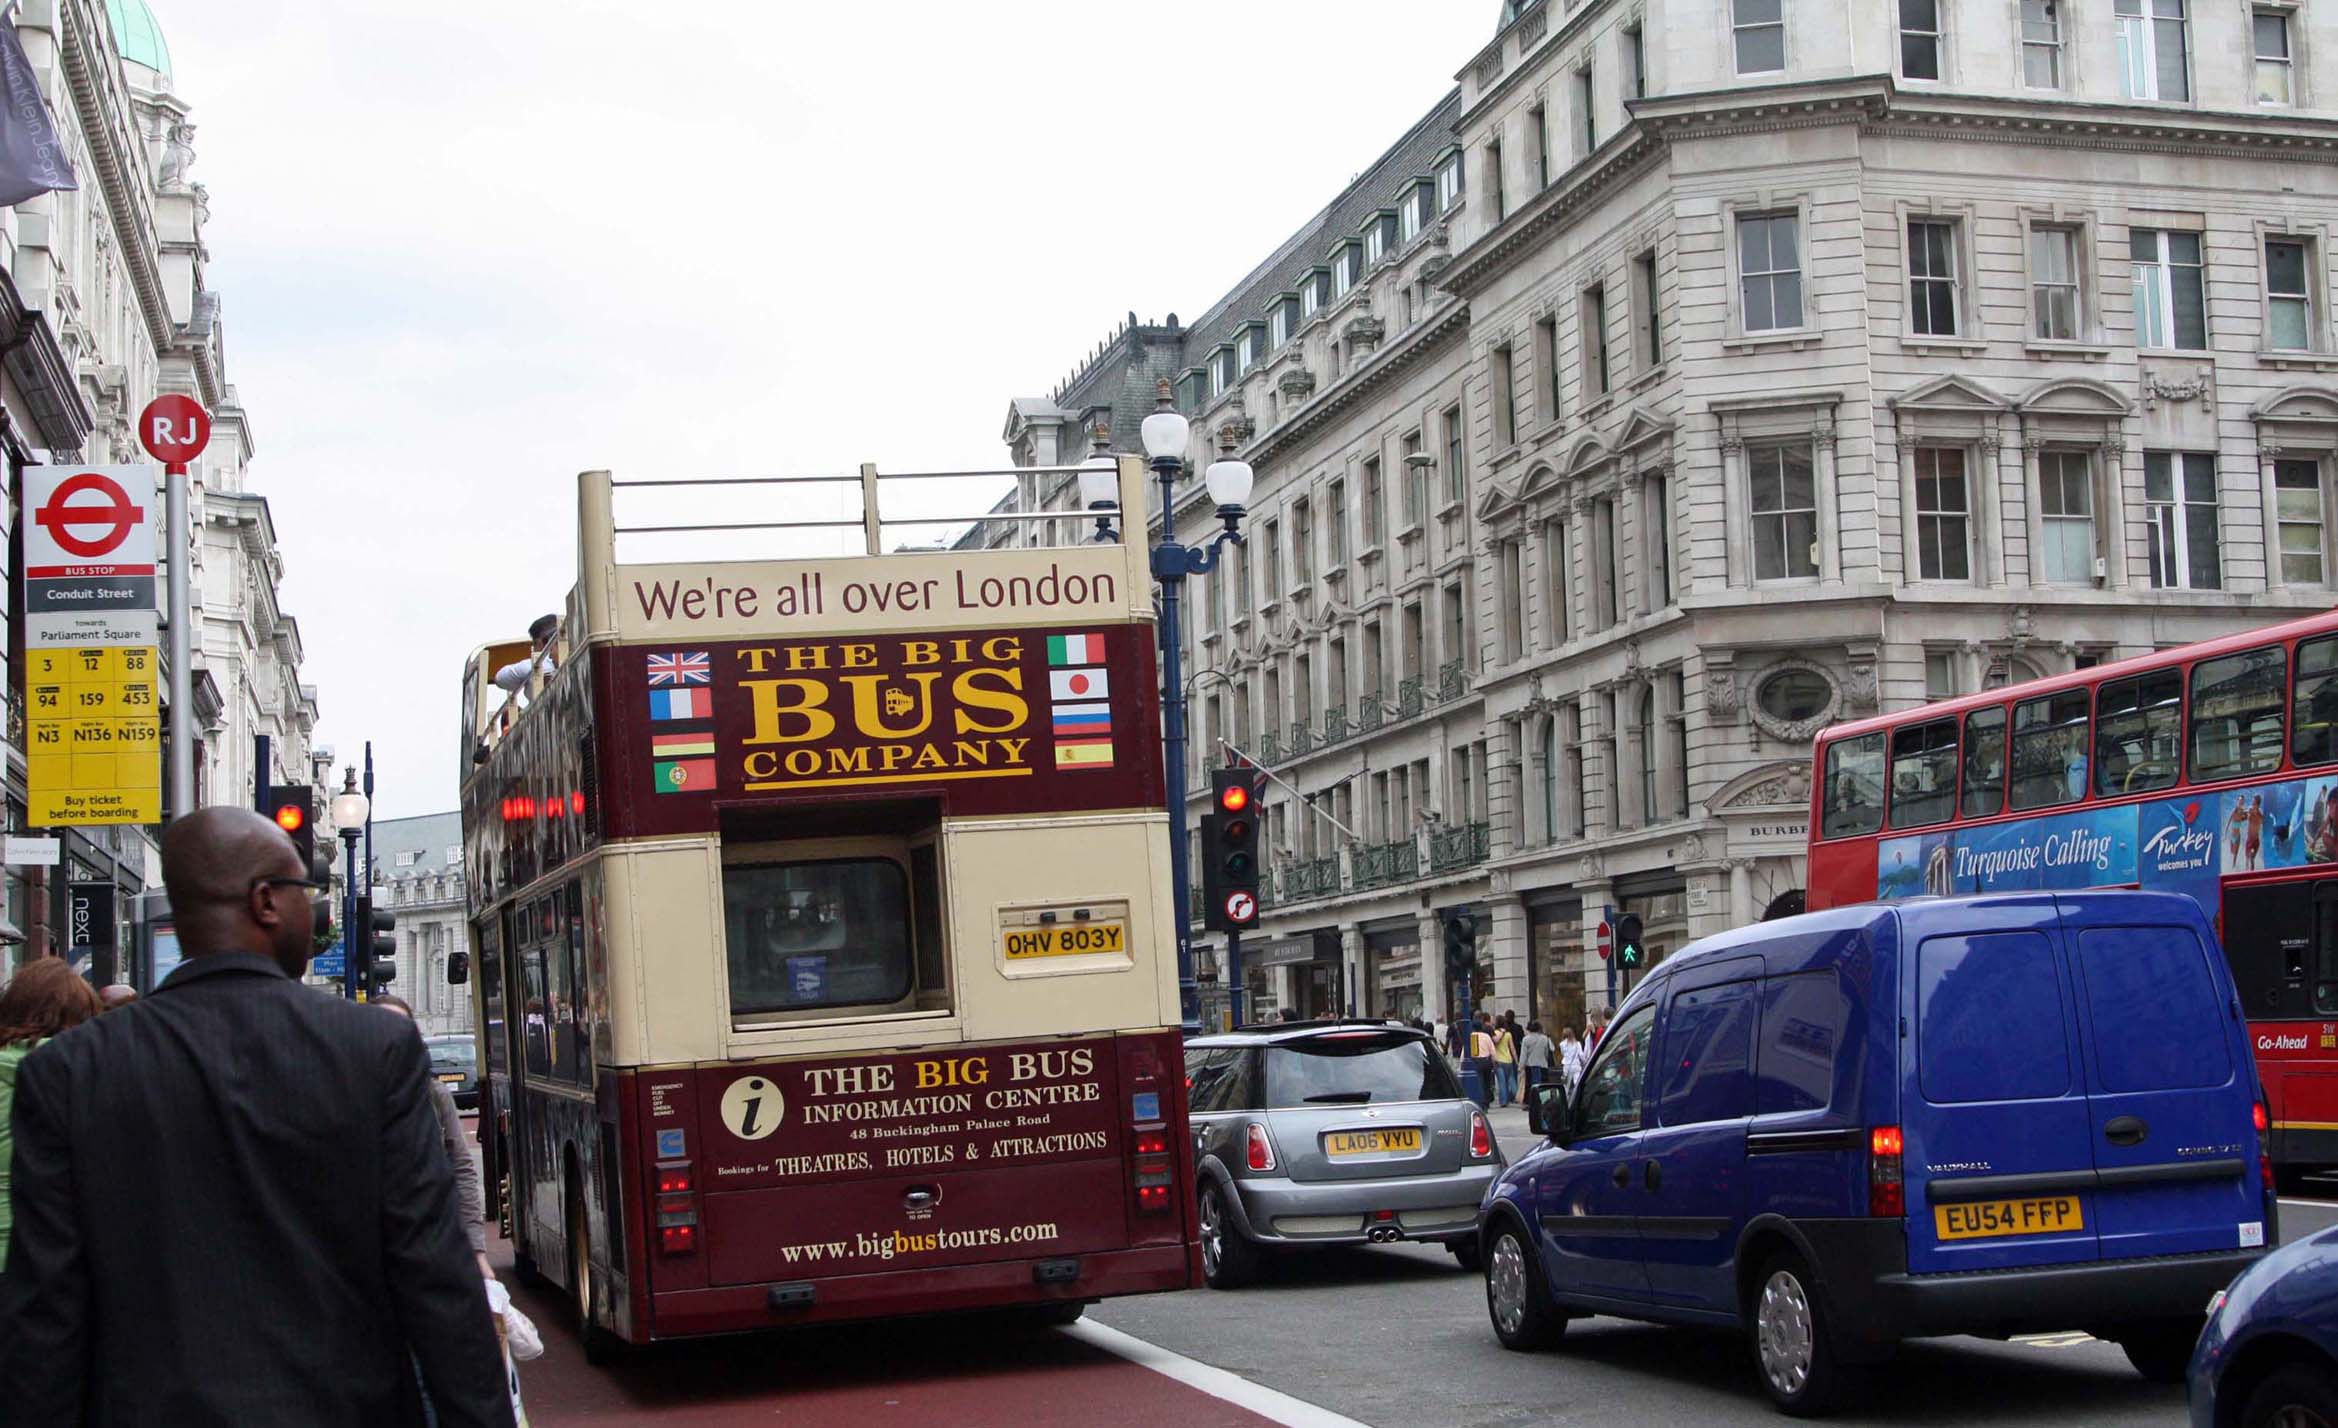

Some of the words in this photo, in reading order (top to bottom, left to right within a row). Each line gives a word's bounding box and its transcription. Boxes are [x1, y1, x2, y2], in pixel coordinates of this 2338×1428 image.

[153, 416, 197, 445] RJ
[65, 567, 86, 575] BUS
[88, 567, 115, 575] STOP
[47, 589, 96, 600] Conduit
[97, 588, 135, 599] Street
[634, 577, 758, 621] We're
[776, 572, 824, 616] all
[842, 580, 939, 614] over
[956, 563, 1115, 609] London
[41, 630, 101, 641] Parliament
[103, 629, 142, 641] Square
[126, 657, 145, 670] 88
[737, 644, 878, 673] THE
[899, 636, 1024, 666] BIG
[43, 659, 52, 672] 3
[84, 658, 99, 671] 12
[38, 694, 58, 707] 94
[80, 693, 104, 706] 159
[122, 691, 151, 705] 453
[738, 667, 1029, 744] BUS
[38, 730, 60, 743] N3
[74, 728, 111, 742] N136
[118, 727, 156, 741] N159
[743, 737, 1031, 778] COMPANY
[65, 796, 86, 806] Buy
[89, 795, 122, 806] ticket
[49, 808, 86, 819] before
[90, 807, 138, 819] boarding
[2143, 825, 2214, 866] Turkey
[1957, 837, 2040, 883] Turquoise
[2044, 828, 2112, 870] Calling
[2157, 860, 2188, 872] welcomes
[2189, 859, 2203, 870] you
[75, 897, 91, 944] next
[1007, 932, 1052, 955] OHV
[1060, 927, 1120, 951] 803Y
[2257, 1034, 2308, 1050] Go-Ahead
[804, 1064, 895, 1097] THE
[914, 1056, 989, 1089] BIG
[1009, 1048, 1094, 1081] BUS
[803, 1093, 973, 1125] INFORMATION
[985, 1082, 1100, 1110] CENTRE
[850, 1128, 867, 1140] 48
[873, 1123, 960, 1138] Buckingham
[966, 1119, 1011, 1131] Palace
[1017, 1113, 1051, 1126] Road
[1335, 1134, 1378, 1151] LA06
[1382, 1130, 1413, 1147] VYU
[718, 1165, 755, 1176] Bookings
[757, 1164, 769, 1173] for
[775, 1151, 873, 1176] THEATRES,
[886, 1144, 954, 1167] HOTELS
[966, 1142, 979, 1161] &
[990, 1130, 1107, 1159] ATTRACTIONS
[1946, 1203, 2015, 1233] EU54
[2021, 1200, 2070, 1227] FFP
[781, 1222, 1059, 1263] www.bigbustours.com
